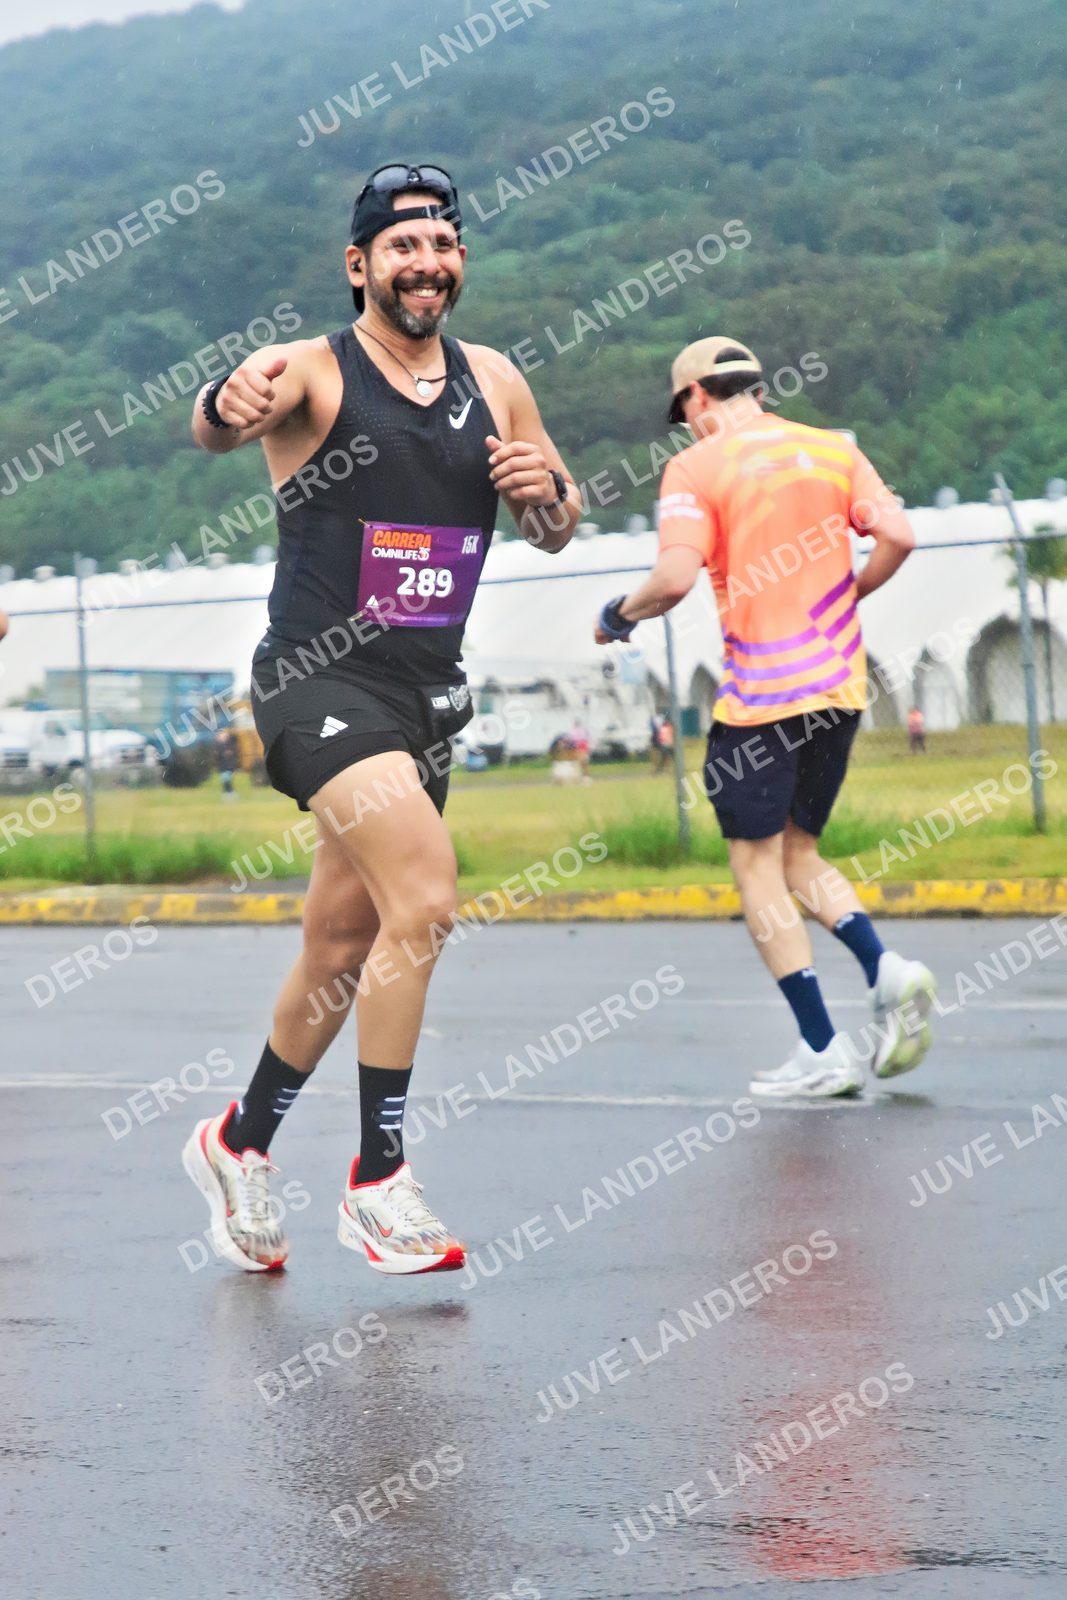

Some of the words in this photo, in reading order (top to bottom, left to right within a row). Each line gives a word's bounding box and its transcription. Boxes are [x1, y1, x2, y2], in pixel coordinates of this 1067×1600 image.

[373, 530, 432, 549] CARRERA
[462, 535, 479, 554] 15K
[397, 567, 452, 597] 289
